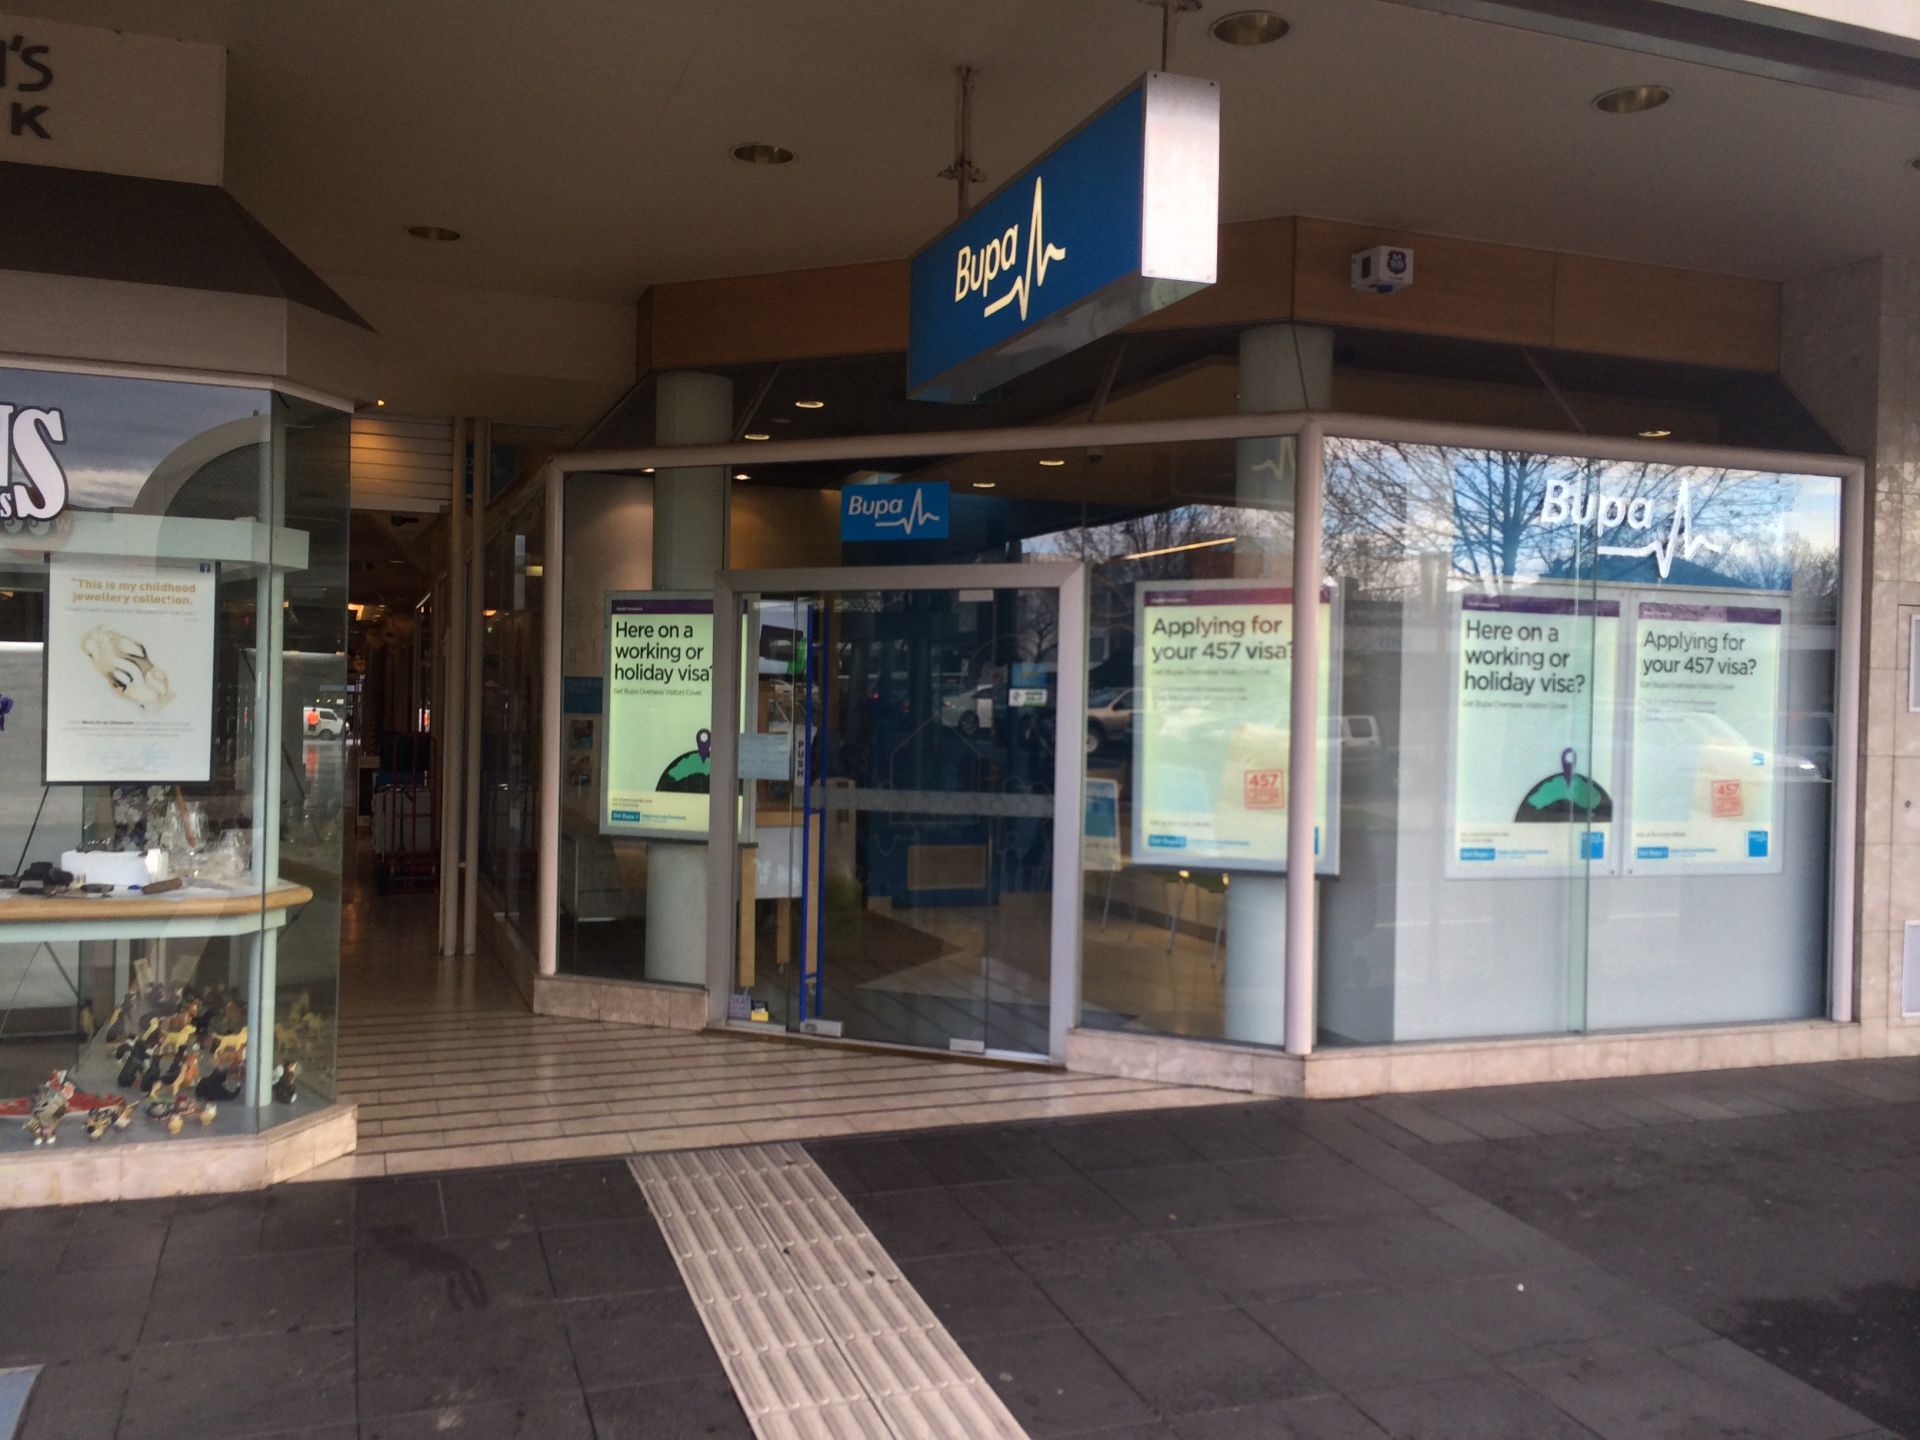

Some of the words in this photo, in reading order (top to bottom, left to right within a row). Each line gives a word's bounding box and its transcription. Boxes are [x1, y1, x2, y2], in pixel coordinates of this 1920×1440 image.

[955, 224, 1019, 303] Bupa
[847, 495, 903, 519] Bupa
[1541, 480, 1654, 537] Bupa
[105, 580, 115, 590] is
[118, 581, 137, 592] my
[139, 582, 196, 593] childhood
[72, 592, 130, 604] jewellery
[133, 595, 193, 605] collection.
[616, 621, 654, 638] Here
[658, 625, 679, 638] on
[683, 625, 693, 638] a
[1152, 616, 1246, 638] Applying
[1251, 615, 1283, 634] for
[1466, 619, 1513, 641] Here
[1517, 625, 1543, 642] on
[1547, 627, 1559, 642] a
[1643, 630, 1718, 653] Applying
[1722, 633, 1746, 651] for
[615, 642, 681, 663] working
[685, 646, 704, 660] or
[1152, 646, 1197, 663] your
[1201, 642, 1241, 659] 457
[1465, 646, 1545, 671] working
[1549, 652, 1571, 668] or
[615, 663, 673, 684] holiday
[678, 664, 712, 681] visa
[1643, 659, 1681, 676] your
[1684, 657, 1714, 674] 457
[1717, 657, 1757, 675] visa?
[1464, 671, 1535, 696] holiday
[1540, 673, 1585, 693] visa?
[1250, 774, 1278, 787] 457
[1717, 784, 1740, 796] 457
